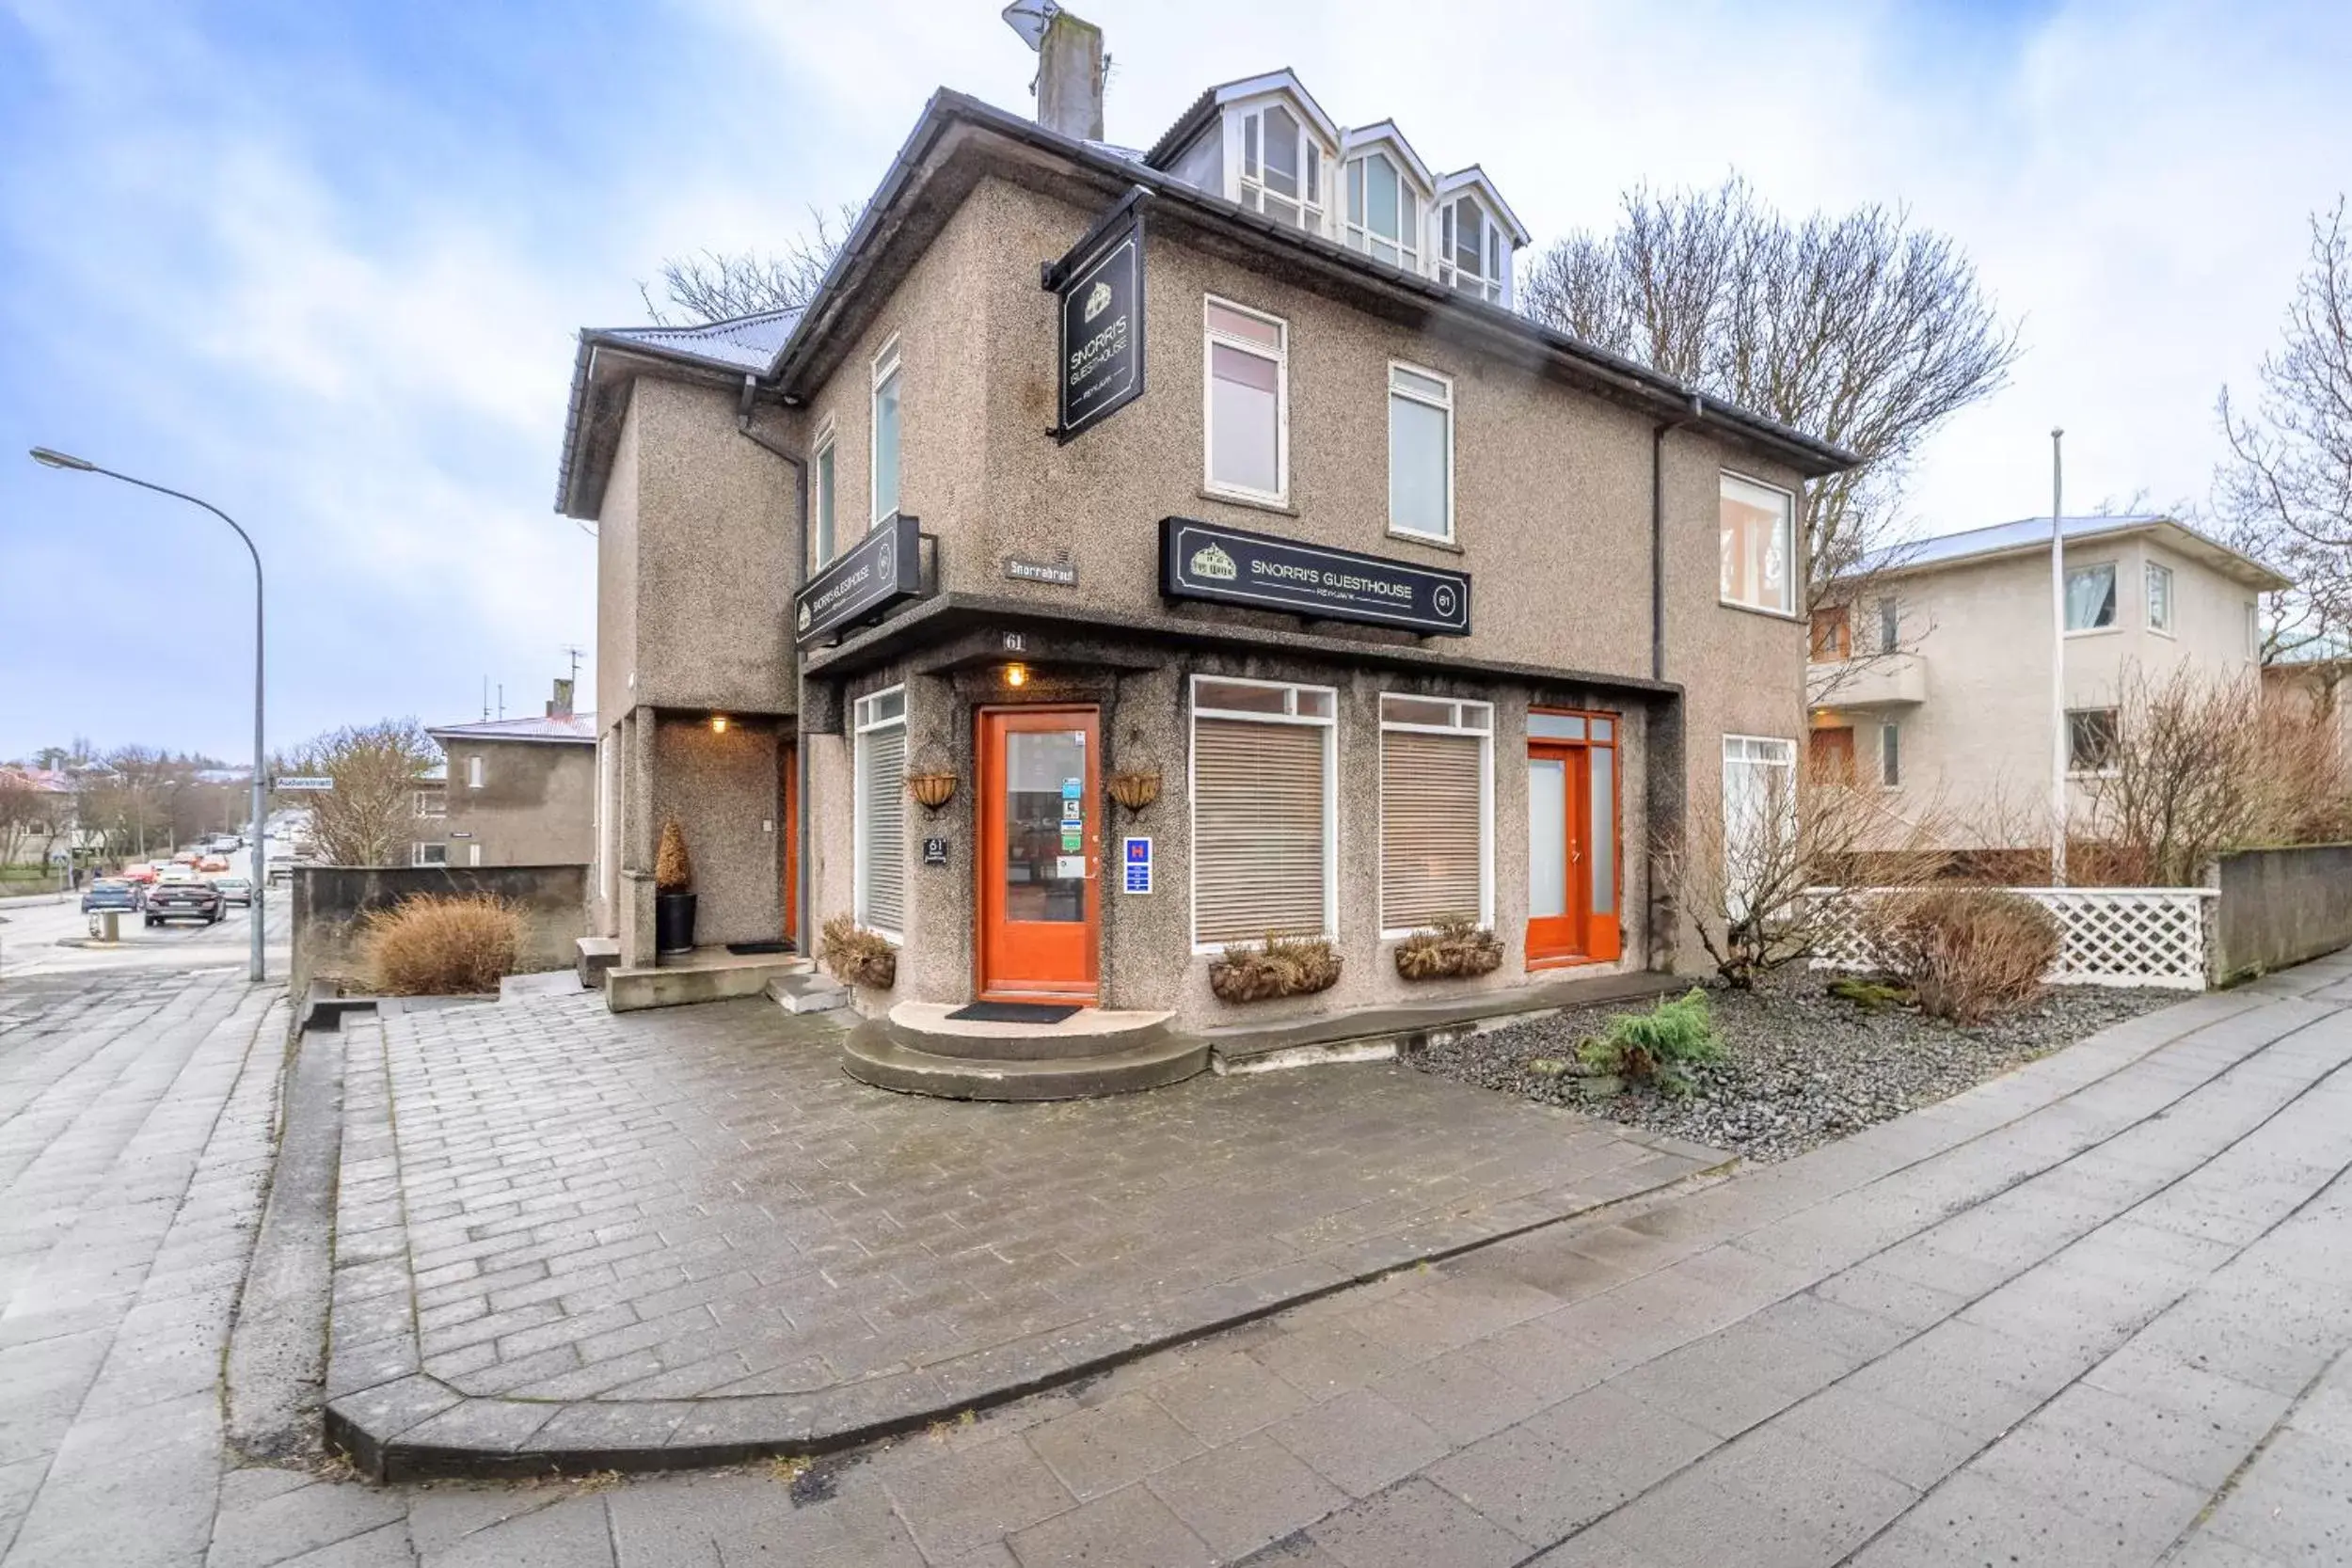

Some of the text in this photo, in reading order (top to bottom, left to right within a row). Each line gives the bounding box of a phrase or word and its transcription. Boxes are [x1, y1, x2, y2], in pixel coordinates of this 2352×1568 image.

[1071, 315, 1127, 370] SNORRI'S
[1071, 335, 1127, 386] GUESTHOUSE
[1251, 560, 1412, 599] SNORRI'S GUESTHOUSE
[1438, 594, 1450, 607] 61
[1006, 633, 1023, 651] 61
[930, 839, 942, 851] 61
